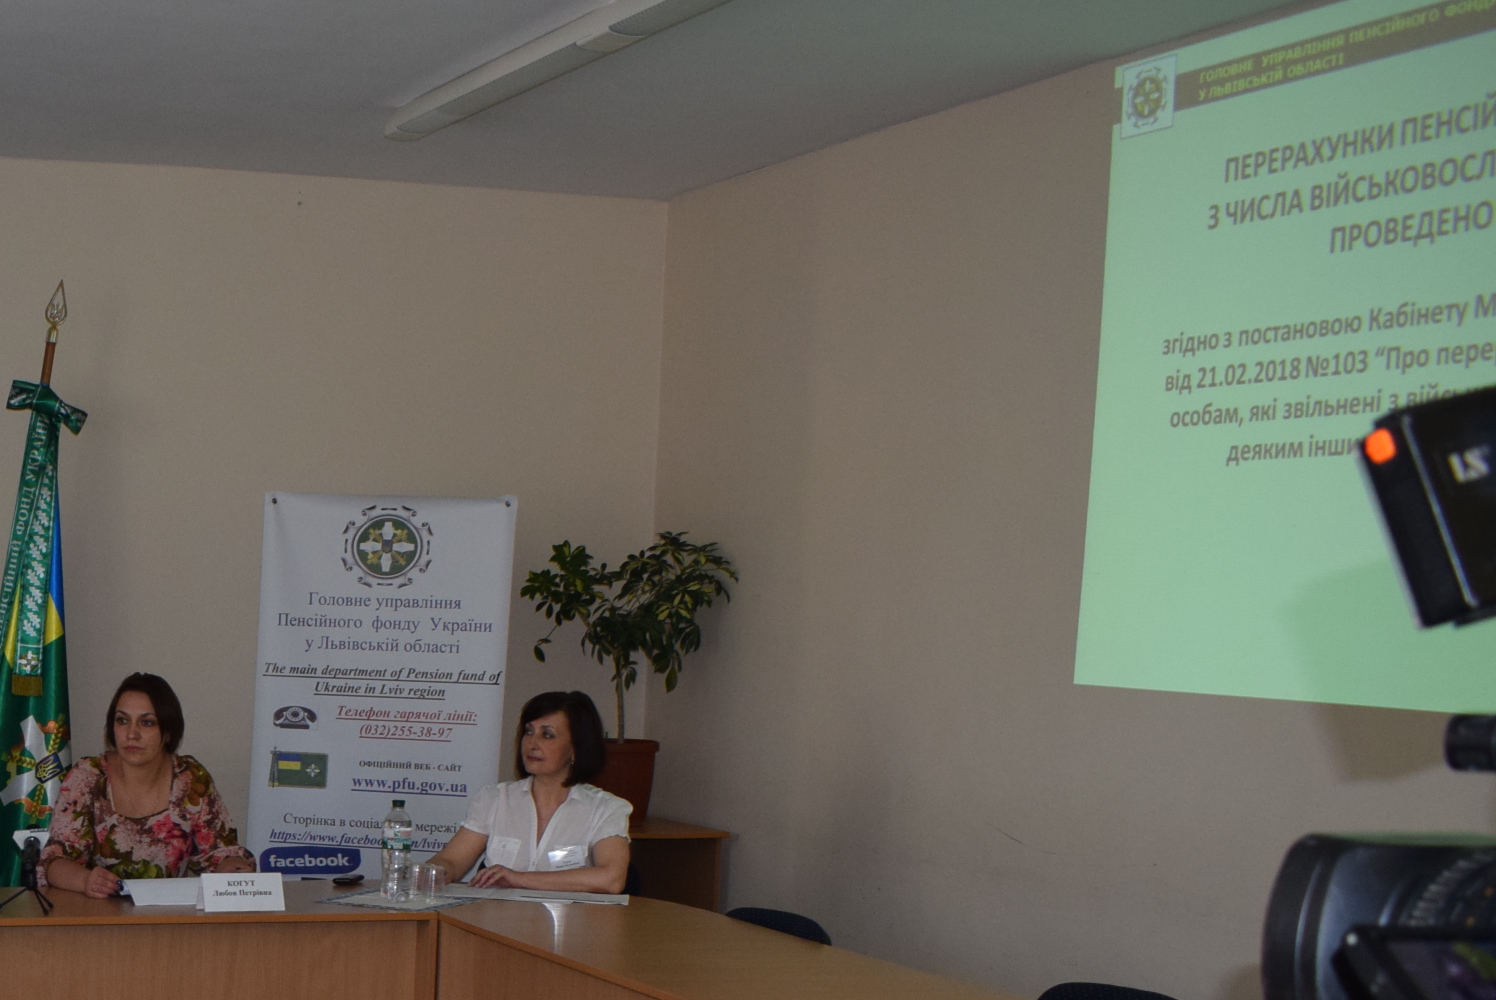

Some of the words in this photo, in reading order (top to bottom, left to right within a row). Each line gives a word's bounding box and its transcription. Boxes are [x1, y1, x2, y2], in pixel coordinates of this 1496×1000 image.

[1200, 59, 1253, 84] ГОЛОВНЕ
[1261, 34, 1344, 67] УПРАВЛІННЯ
[1287, 53, 1345, 77] ОБЛАСТІ
[1224, 121, 1394, 183] ПЕРЕРАХУНКИ
[1207, 204, 1220, 231] З
[1225, 187, 1303, 227] ЧИСЛА
[1330, 201, 1494, 254] ПРОВЕДЕНО
[1162, 331, 1220, 356] згідно
[1223, 332, 1232, 348] з
[1238, 313, 1363, 347] постановою
[1368, 301, 1469, 332] Кабінету
[1165, 371, 1192, 396] від
[1196, 357, 1302, 389] 21.02.2018
[1304, 350, 1369, 379] №103
[1436, 342, 1496, 369] пере
[1169, 402, 1244, 428] особам,
[1249, 398, 1277, 423] які
[1282, 388, 1382, 420] звільнені
[1226, 437, 1303, 466] деяким
[16, 486, 36, 535] ФОНД
[308, 592, 371, 607] Головне
[375, 595, 462, 611] управління
[277, 613, 363, 628] Пенсійного
[372, 616, 420, 633] фонду
[430, 617, 493, 634] України
[305, 640, 314, 652] у
[318, 636, 399, 652] Львівській
[404, 639, 460, 654] області
[264, 662, 285, 675] The
[289, 664, 317, 676] main
[321, 665, 387, 680] department
[390, 667, 404, 681] of
[406, 668, 453, 681] Pension
[456, 669, 485, 683] fund
[488, 671, 503, 684] of
[314, 681, 362, 694] Ukraine
[365, 683, 377, 695] in
[379, 683, 405, 696] Lviv
[407, 686, 446, 699] region
[336, 705, 390, 720] Телефон
[393, 708, 442, 722] гарячої
[444, 711, 478, 723] лінії:
[359, 724, 453, 739] (032)255-38-97
[359, 760, 412, 770] ОФІЦІЙНИЙ
[414, 762, 431, 771] ВЕБ
[437, 763, 462, 772] САЙТ
[352, 777, 467, 794] www.pfu.gov.ua
[283, 813, 336, 828] Сторінка
[415, 823, 456, 835] мережі
[268, 853, 350, 868] facebook
[239, 889, 272, 898] Петрівна
